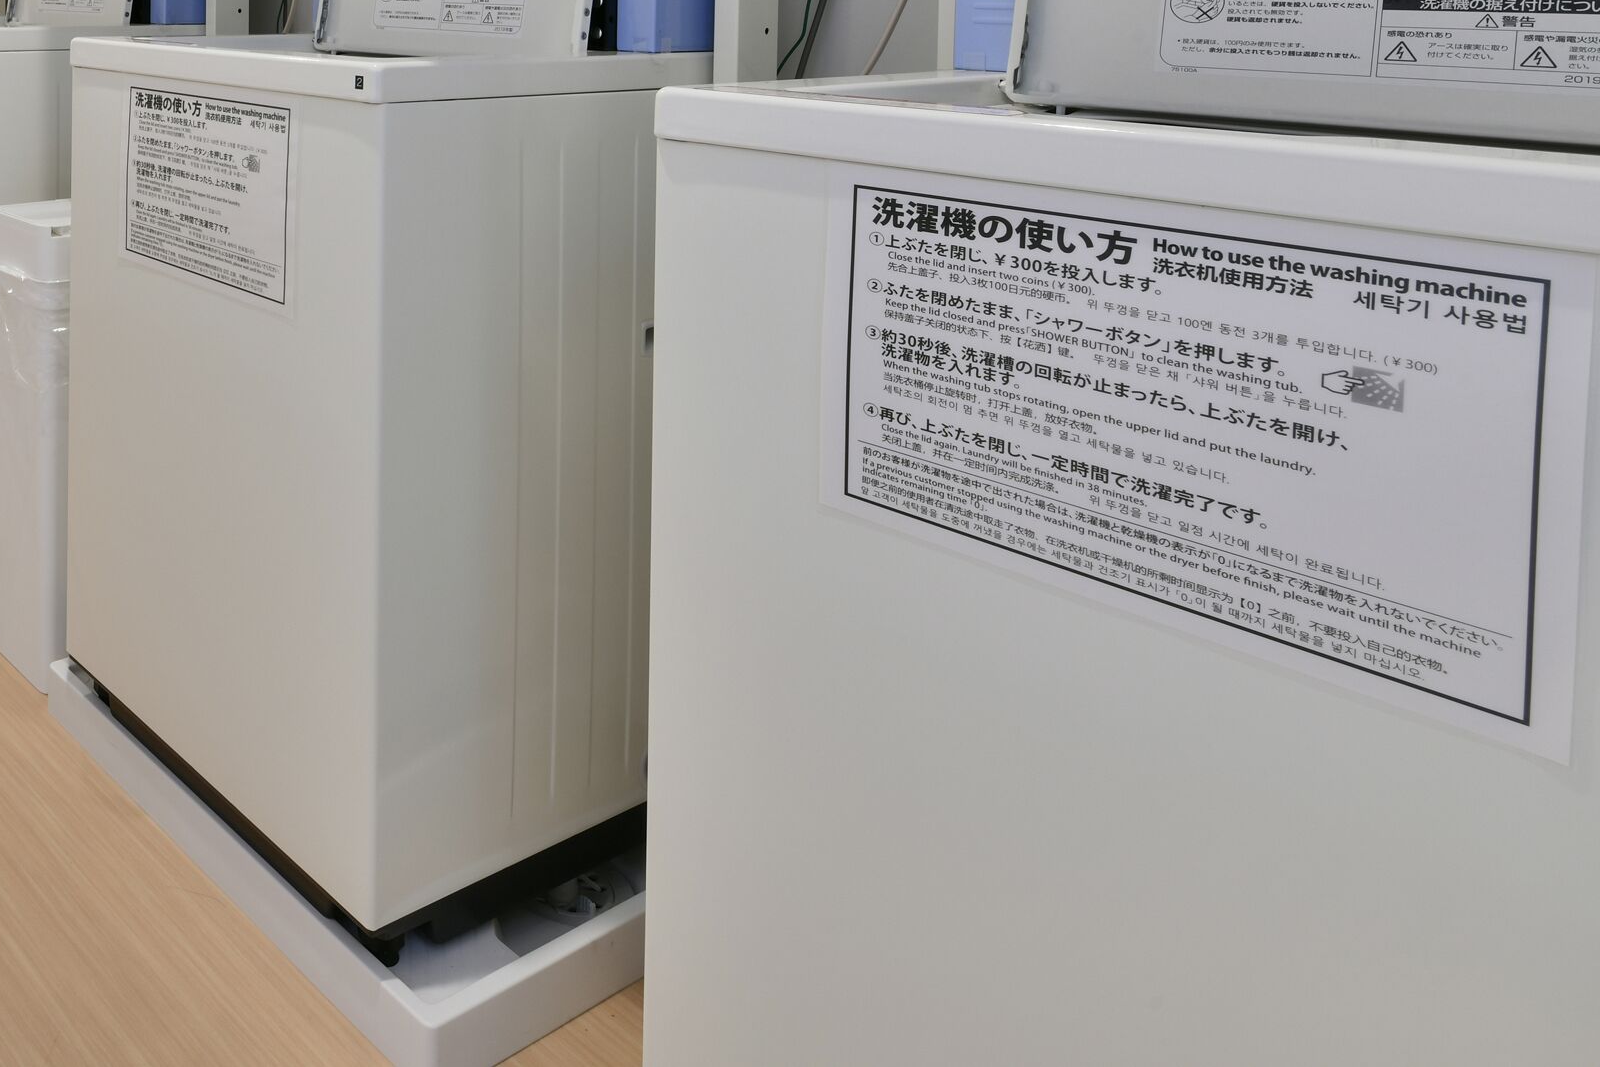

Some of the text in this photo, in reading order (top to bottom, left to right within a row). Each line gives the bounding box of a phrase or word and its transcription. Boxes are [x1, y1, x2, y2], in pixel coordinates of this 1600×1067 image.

[1502, 15, 1536, 28] 警告
[135, 92, 202, 117] 洗濯機の使い方
[205, 103, 216, 111] How
[232, 107, 240, 115] the
[240, 109, 262, 120] washing
[262, 112, 286, 122] machine
[871, 196, 1137, 265] 洗濯機の使い方
[887, 250, 912, 262] Close
[914, 255, 930, 265] the
[932, 258, 944, 268] lid
[946, 263, 965, 272] and
[968, 264, 996, 278] insert
[998, 271, 1018, 281] two
[1021, 276, 1048, 287] coins
[1152, 237, 1527, 307] How to use the washing machine
[1152, 256, 1313, 298] 洗衣机使用方法
[881, 342, 1019, 389] 洗濯物を入れます。
[885, 297, 908, 310] Keep
[910, 303, 926, 313] the
[928, 306, 940, 316] lid
[942, 310, 973, 323] closed
[976, 318, 995, 328] and
[1141, 352, 1153, 361] to
[1156, 355, 1188, 369] clean
[1192, 362, 1213, 374] the
[1216, 368, 1271, 389] washing
[1274, 380, 1302, 393] tub.
[882, 358, 1315, 475] When the washing tub stops rotating, open the upper lid and put the laundry.
[881, 423, 1147, 507] Close the lid again. Laundry will be finished in 38 minutes.
[862, 456, 1480, 658] If a previous customer stopped using the washing machine or the dryer before finish, please wait until the machine
